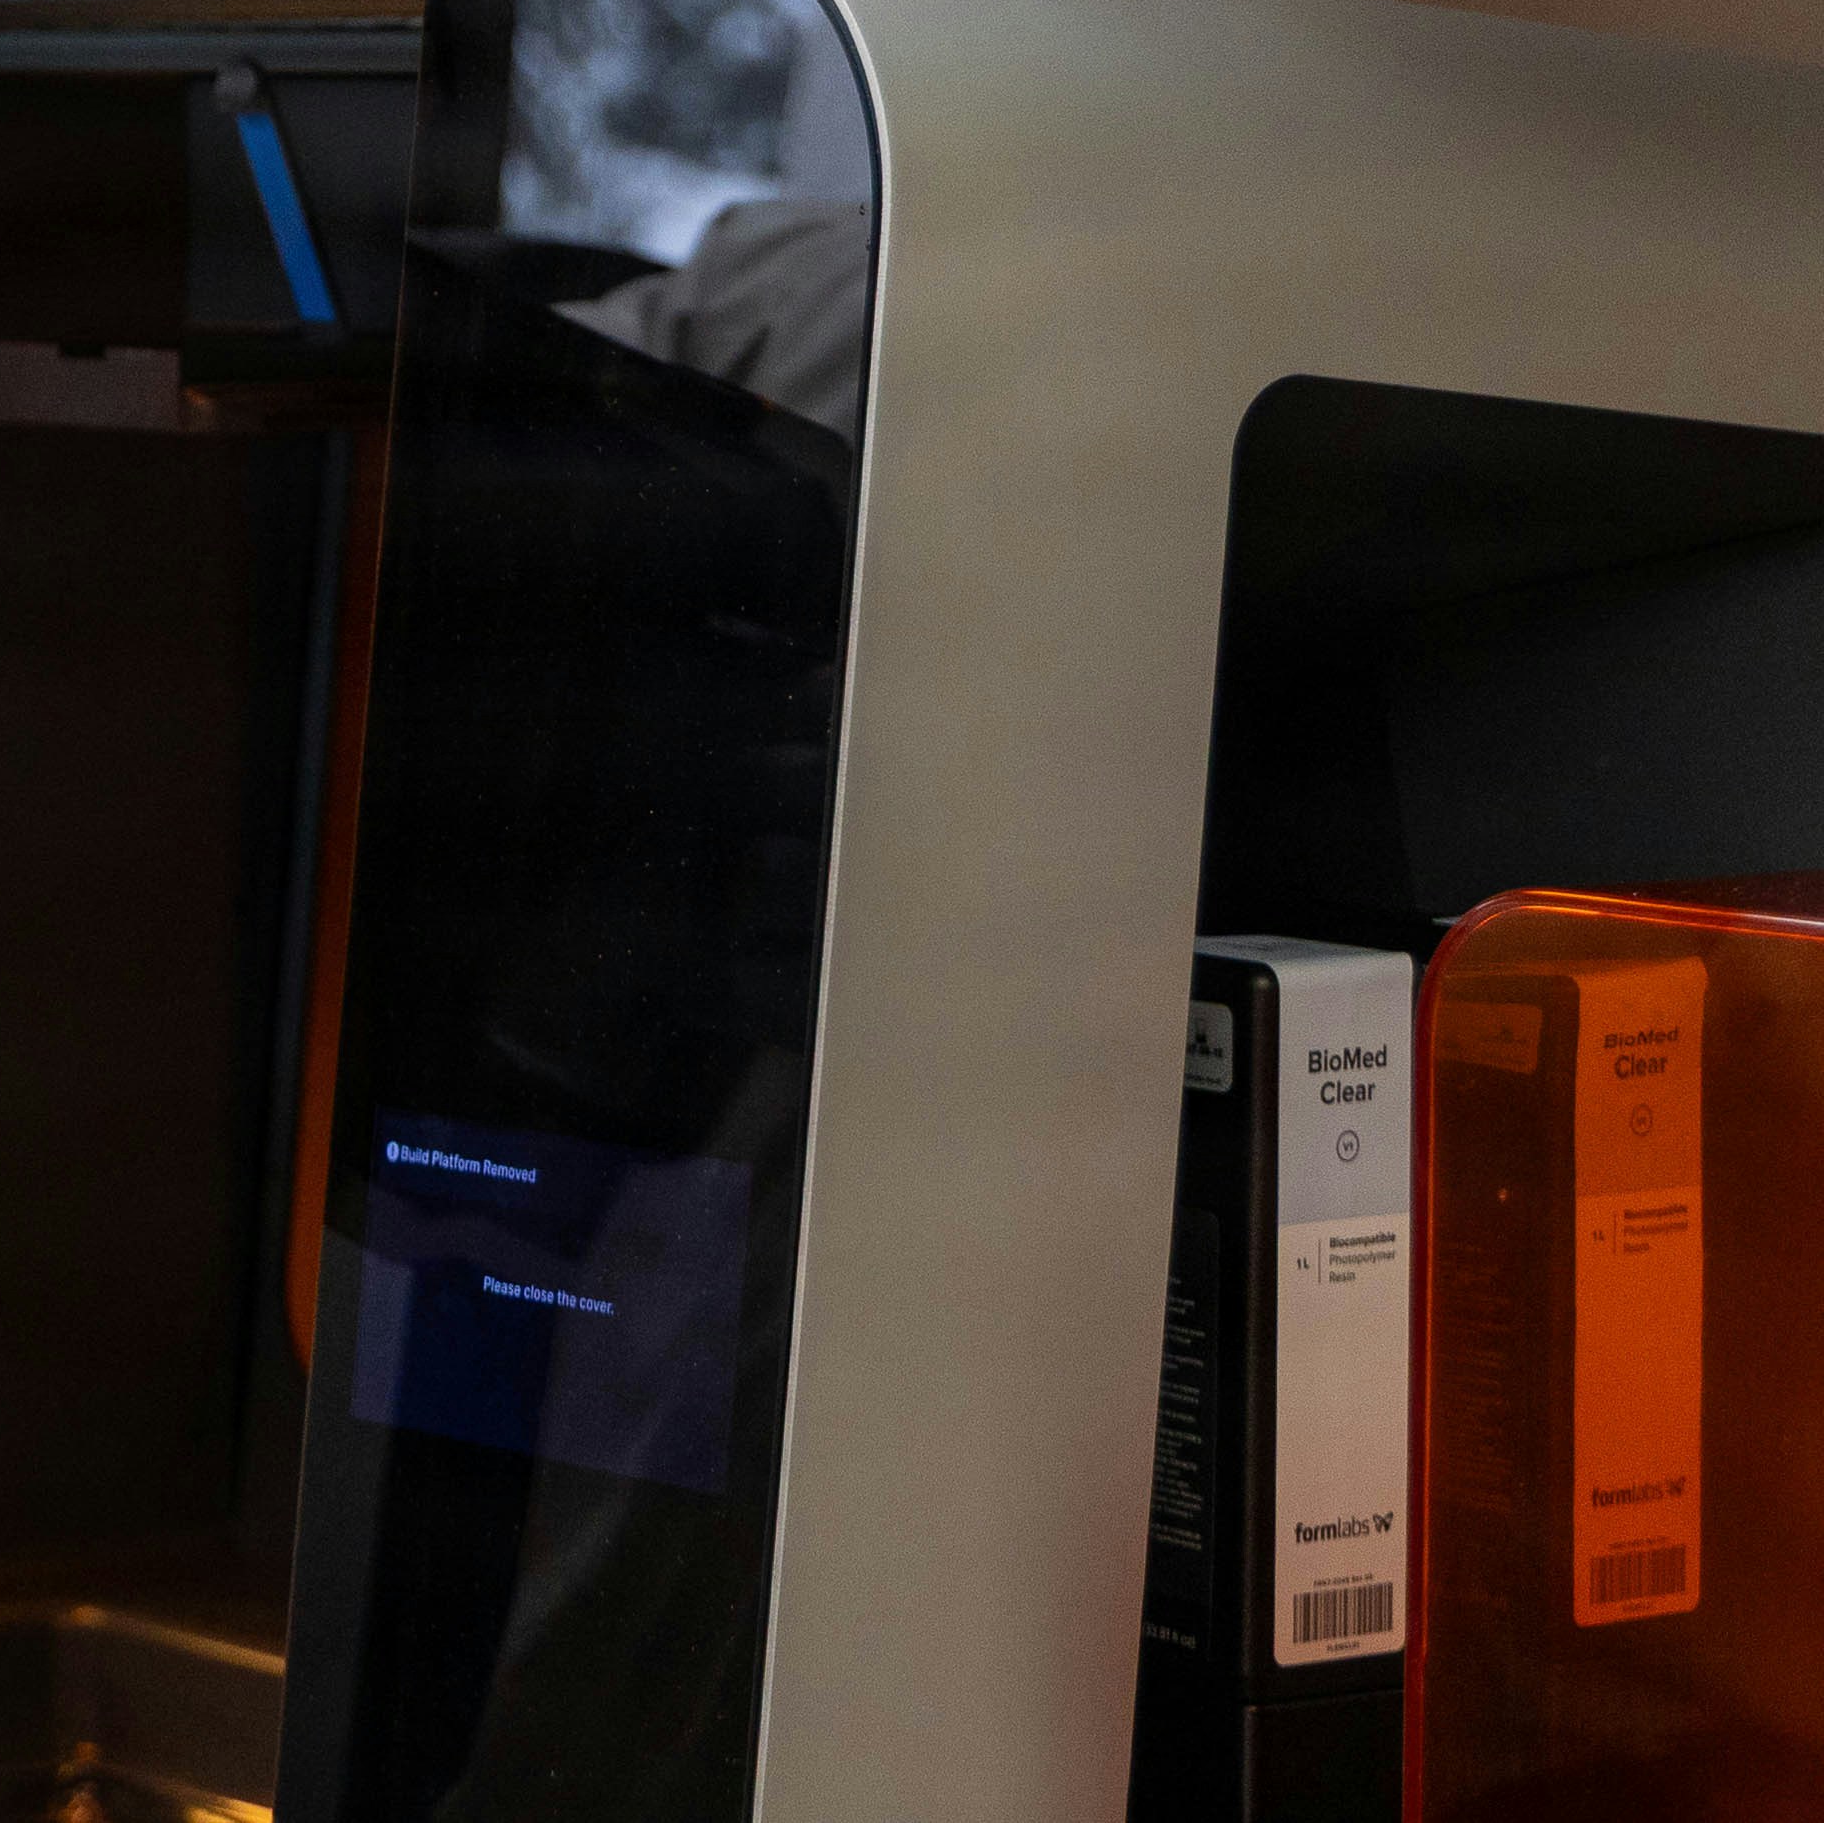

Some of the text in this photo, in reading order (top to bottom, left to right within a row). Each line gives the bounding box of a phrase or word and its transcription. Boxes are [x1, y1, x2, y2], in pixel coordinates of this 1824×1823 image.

[1604, 1027, 1679, 1049] BioMed
[1308, 1045, 1388, 1074] BioMed
[1615, 1054, 1668, 1080] Clear
[1320, 1080, 1376, 1105] Clear
[401, 1145, 536, 1184] Build Platform Removed
[1329, 1231, 1396, 1248] Biocompatible
[1329, 1248, 1396, 1267] Photopolymer
[1329, 1270, 1356, 1284] Resin
[483, 1275, 616, 1316] Please close the cover.
[1593, 1482, 1664, 1508] formlabs
[1296, 1516, 1371, 1544] formlabs
